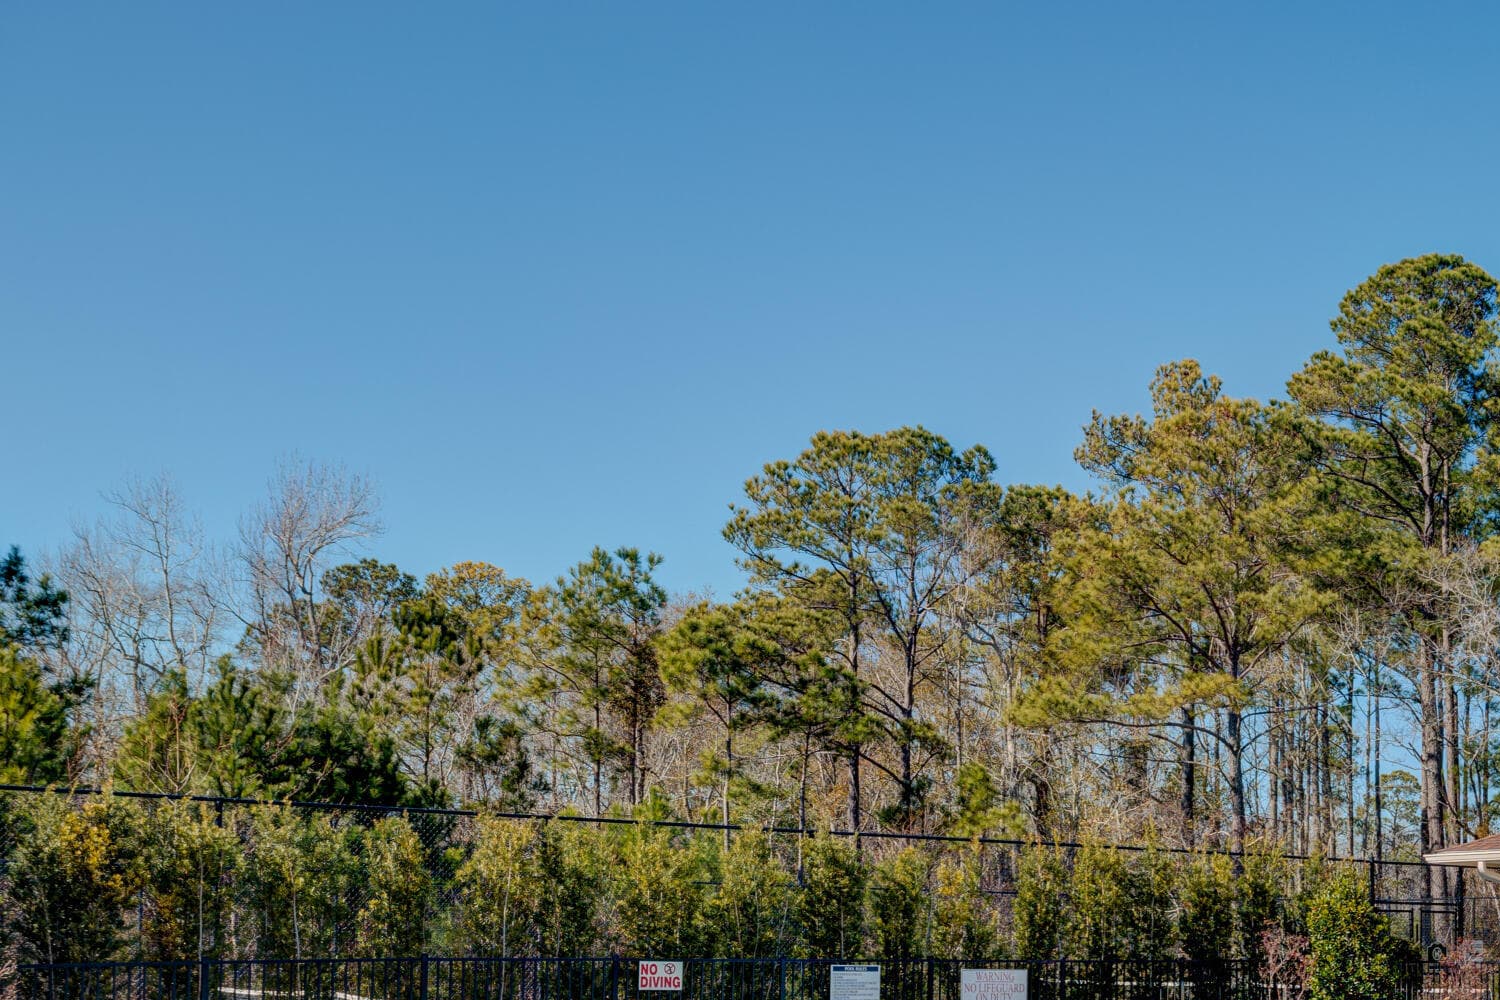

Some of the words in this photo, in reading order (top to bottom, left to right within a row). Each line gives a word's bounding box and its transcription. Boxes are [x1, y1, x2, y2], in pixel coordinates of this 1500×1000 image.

[640, 963, 658, 975] NO
[976, 972, 1014, 981] WARNING
[640, 976, 681, 988] DIVING
[965, 984, 976, 992] NO
[979, 984, 1025, 992] LIFEGUARD
